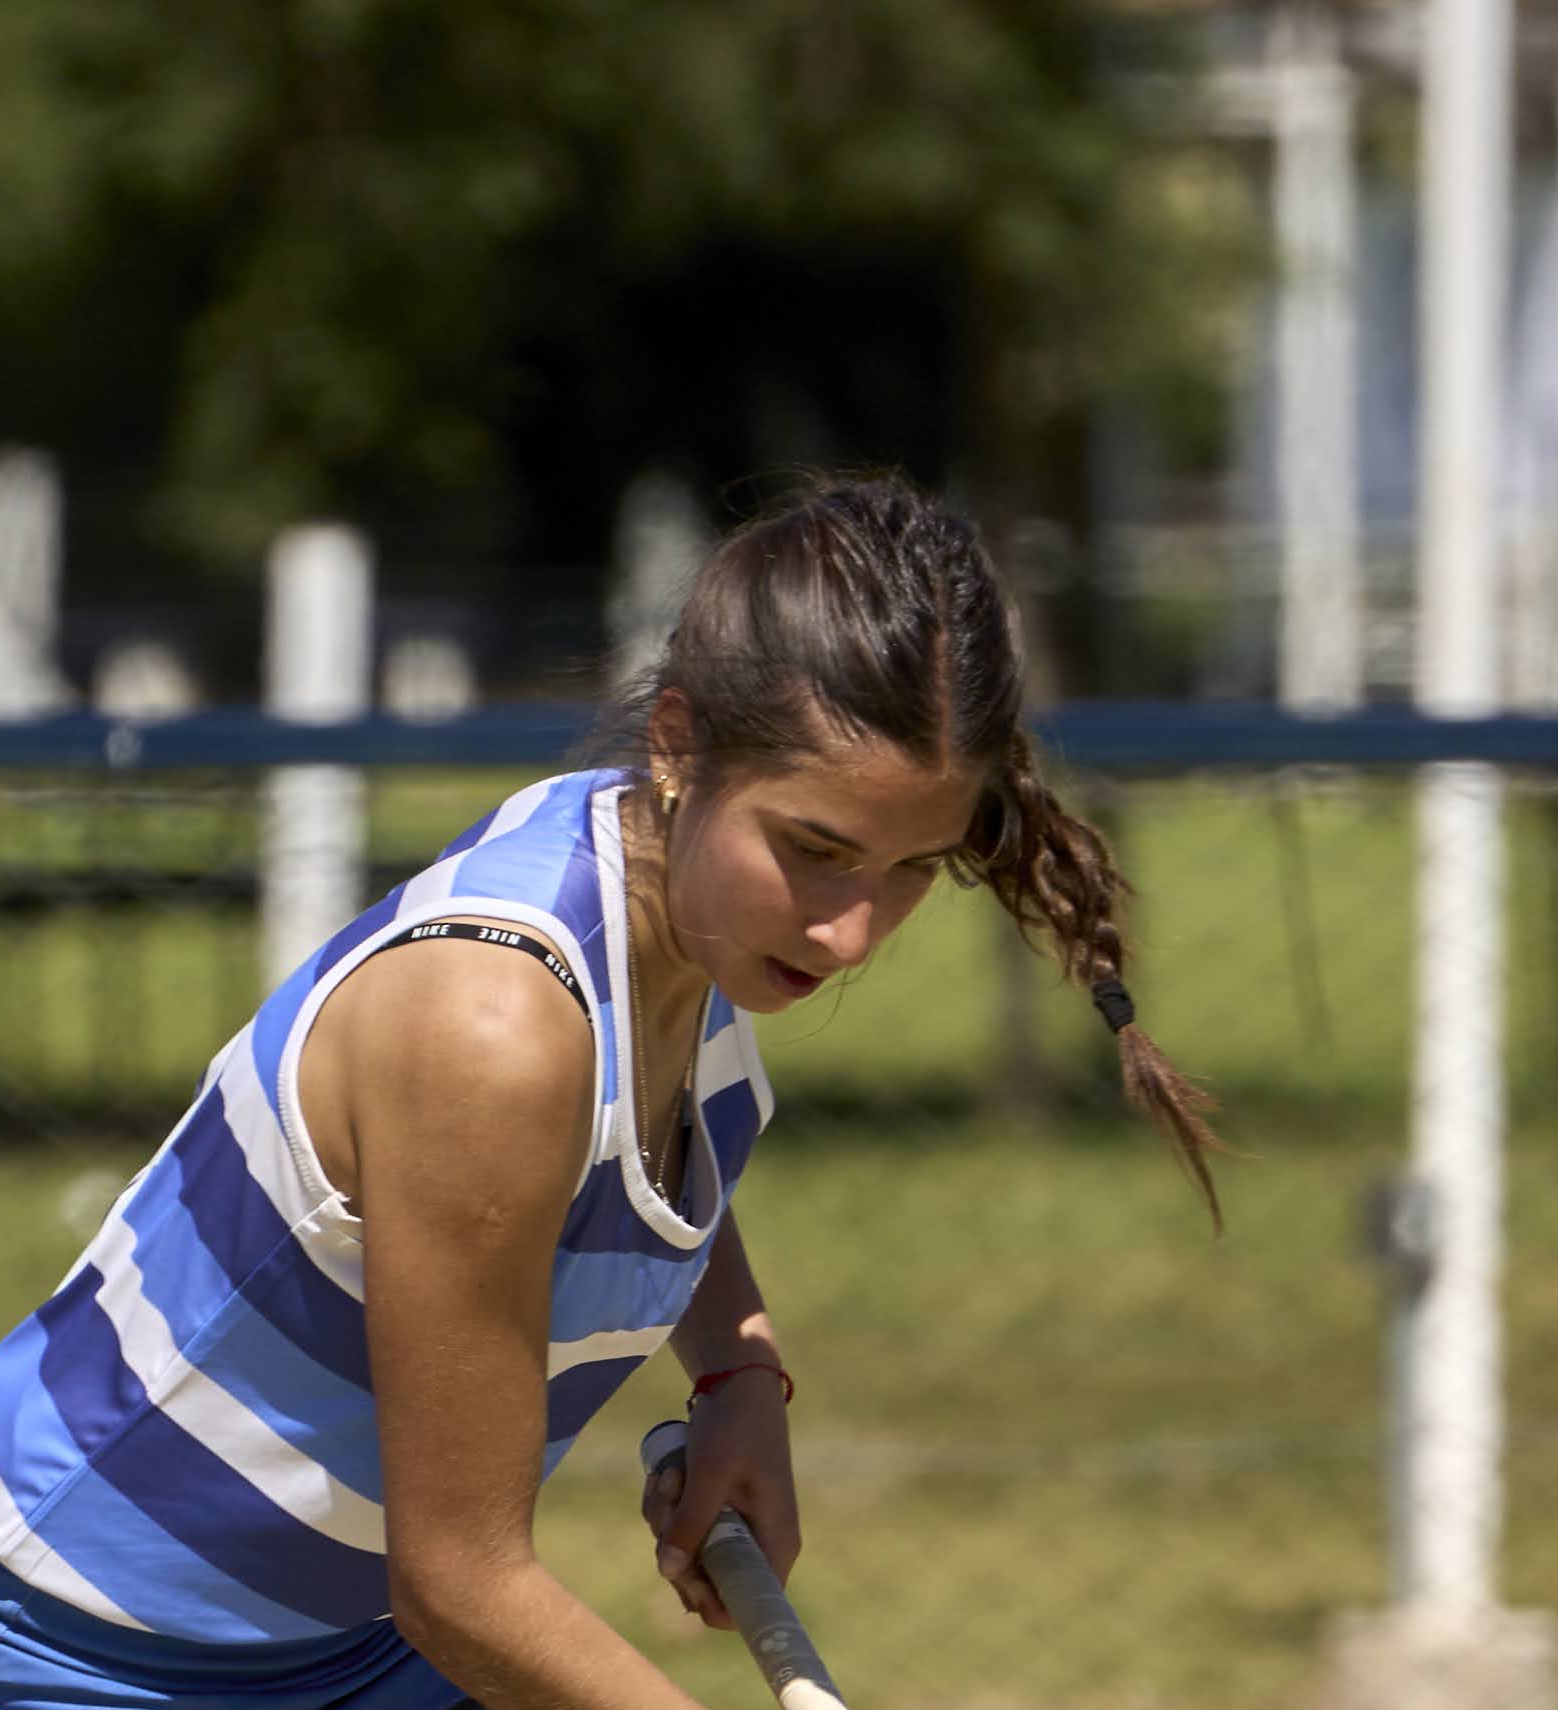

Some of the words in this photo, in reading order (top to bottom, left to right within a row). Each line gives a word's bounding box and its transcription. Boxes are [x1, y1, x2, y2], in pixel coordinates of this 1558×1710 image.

[409, 923, 452, 939] NIKE
[476, 926, 521, 946] NIKE
[543, 952, 575, 989] NIKE
